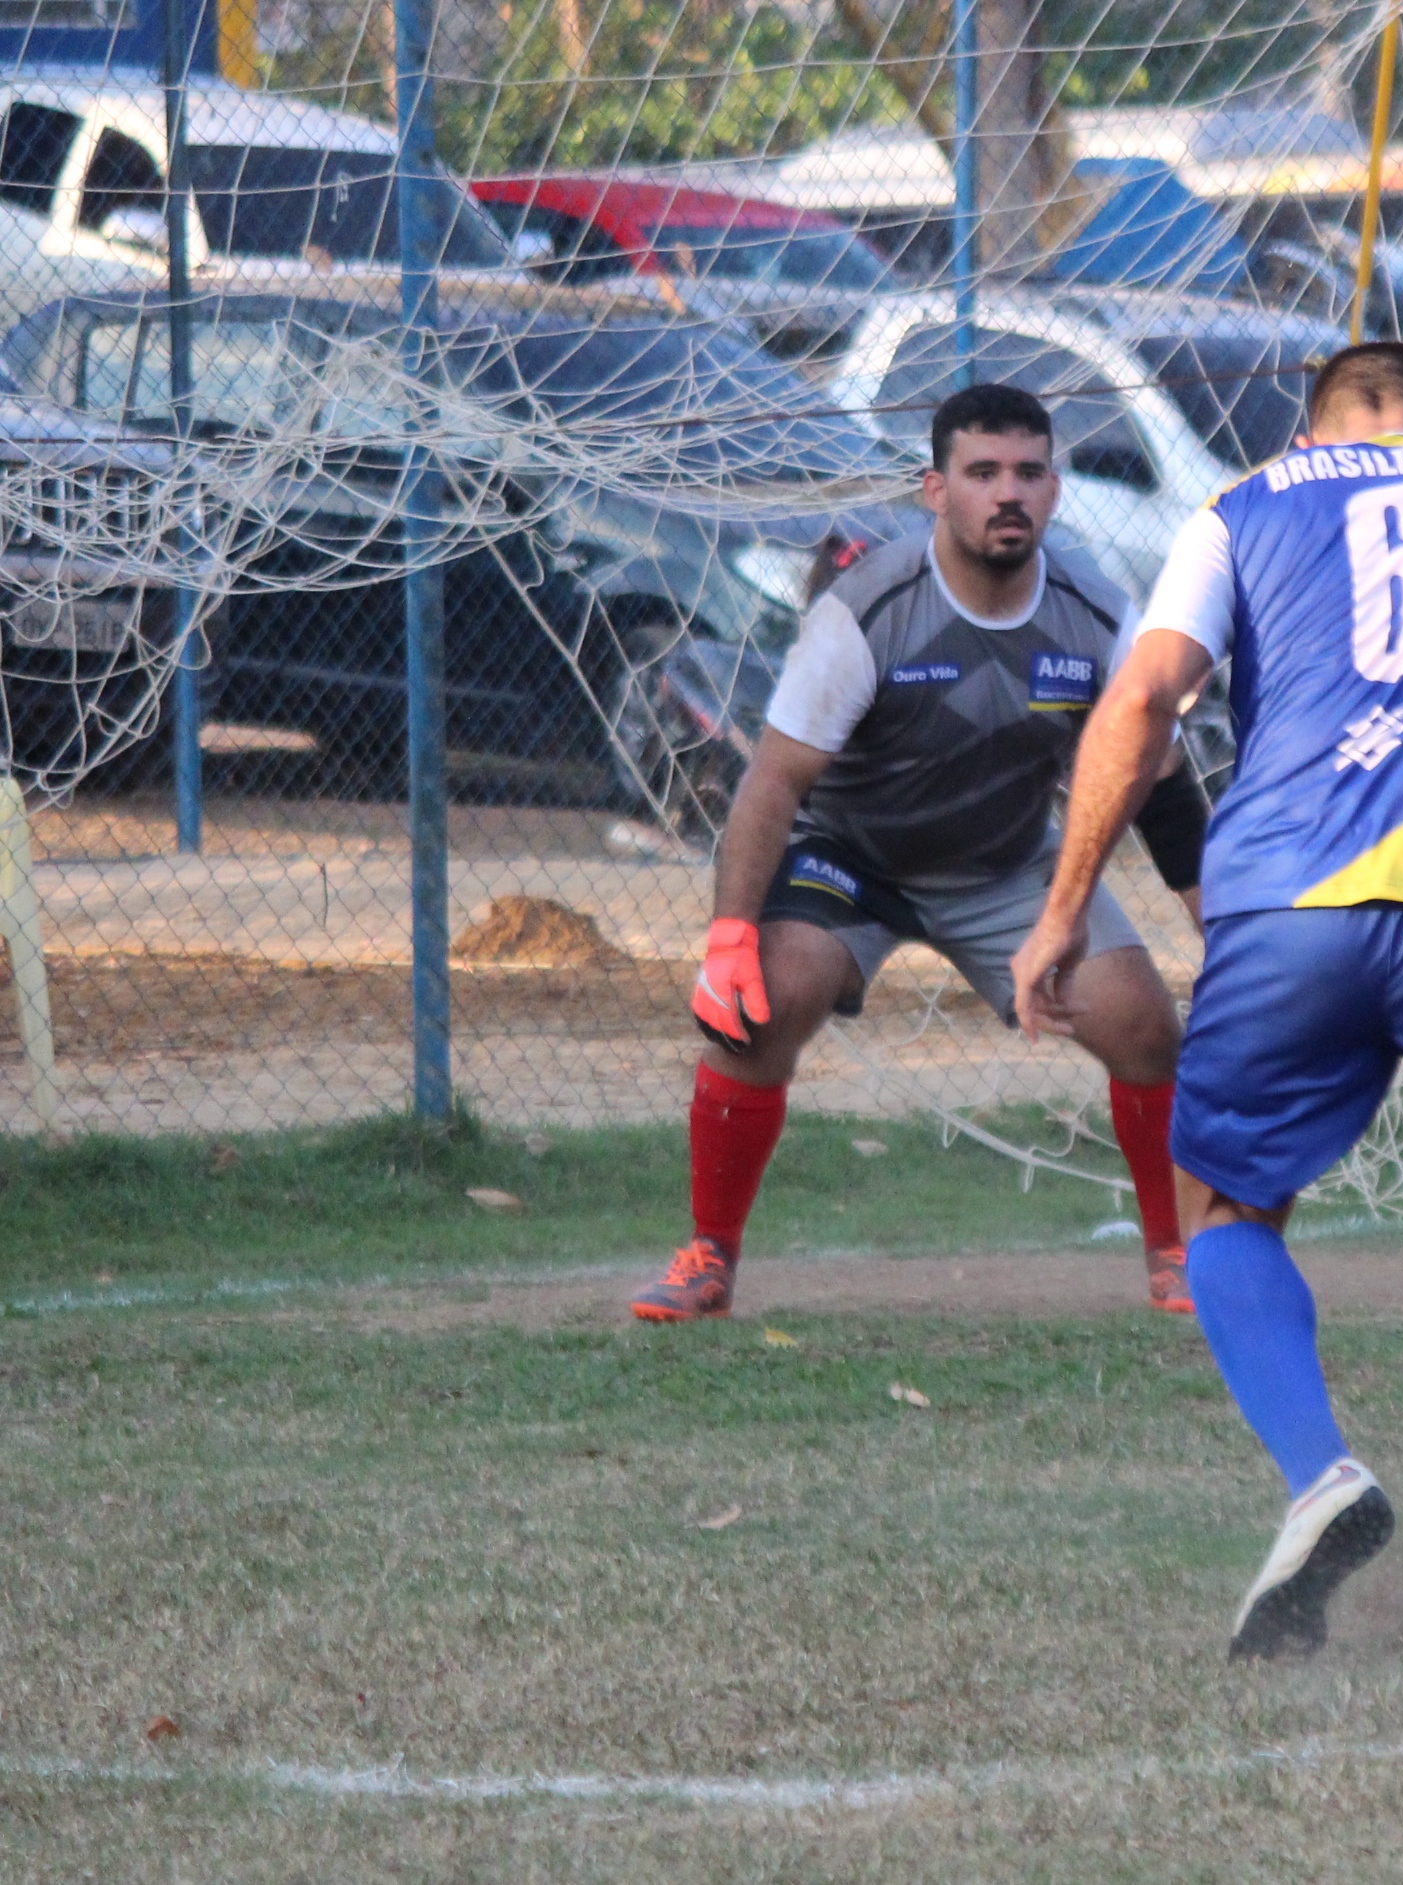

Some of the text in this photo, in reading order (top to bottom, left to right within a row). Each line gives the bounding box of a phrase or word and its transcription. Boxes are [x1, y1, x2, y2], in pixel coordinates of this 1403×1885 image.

[892, 666, 959, 683] Ouro Vida
[1038, 656, 1093, 682] AABB
[803, 857, 857, 894] AABB
